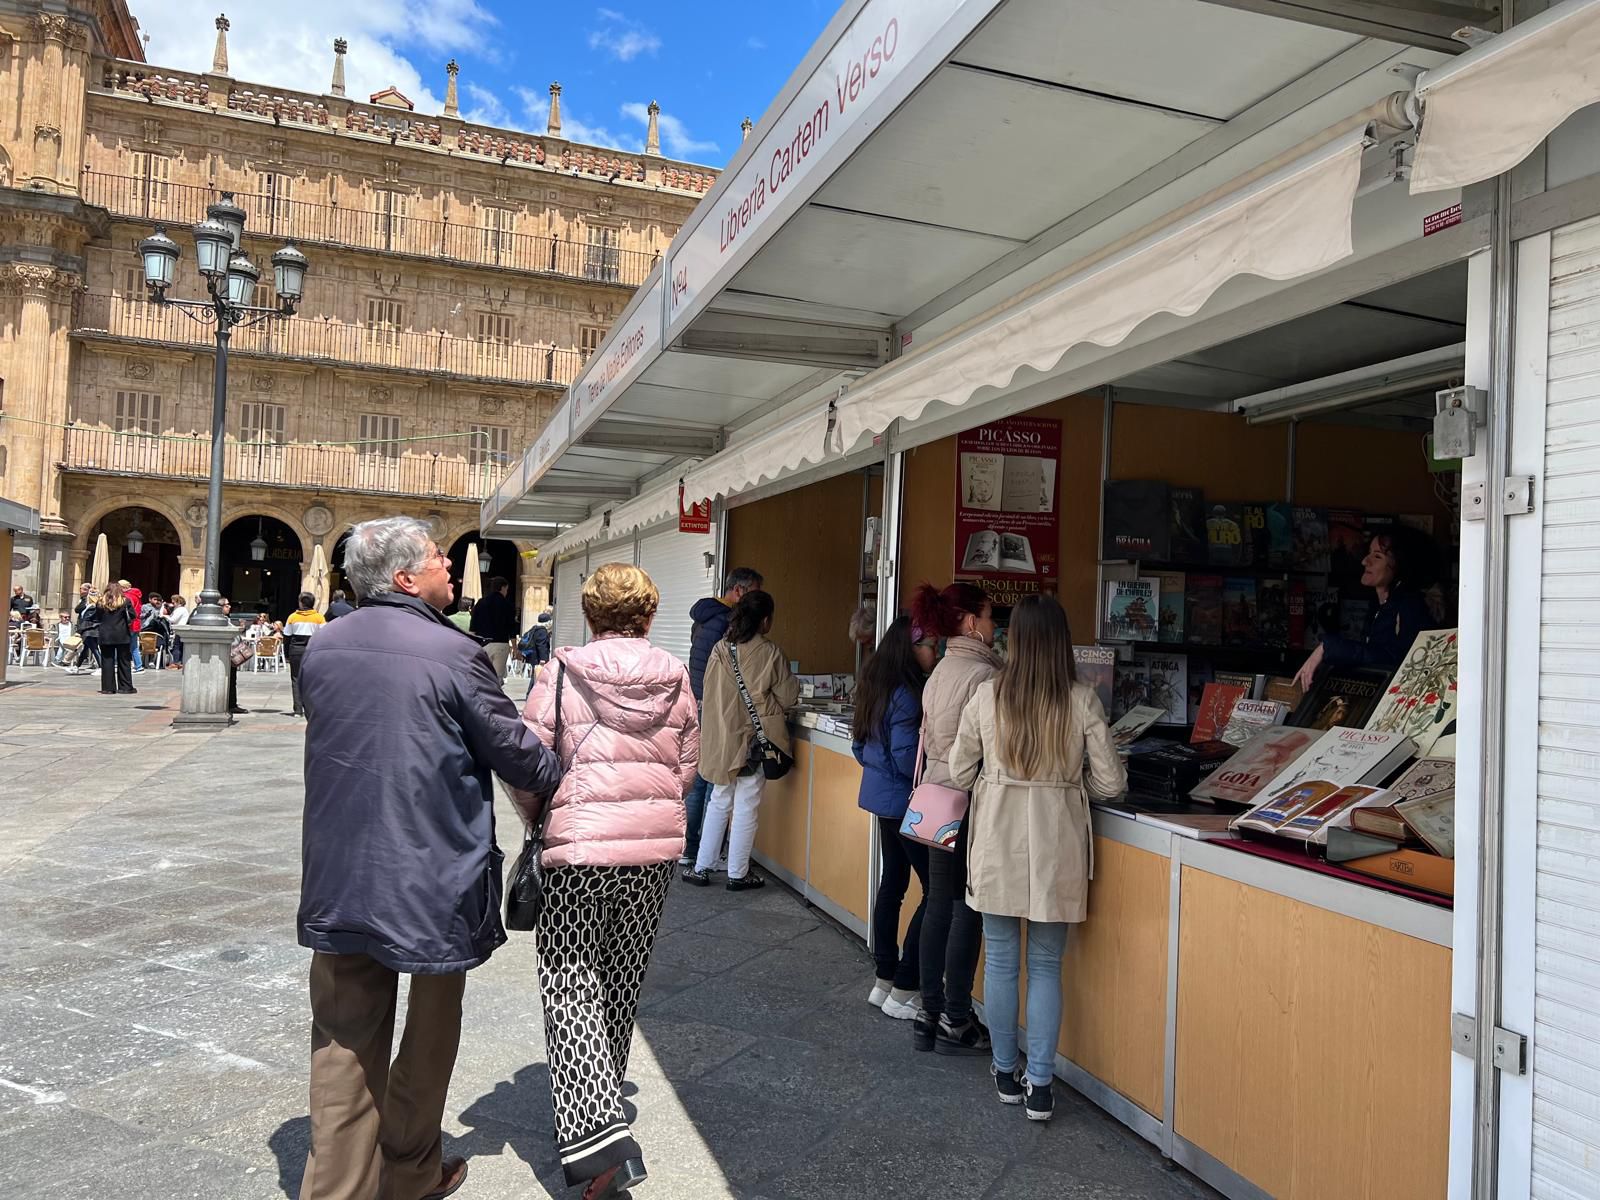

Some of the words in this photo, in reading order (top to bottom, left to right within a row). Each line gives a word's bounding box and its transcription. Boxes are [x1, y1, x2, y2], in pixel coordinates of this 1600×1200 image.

[720, 174, 766, 254] Librería
[769, 99, 829, 194] Cartem
[836, 16, 899, 115] Verso
[620, 325, 644, 368] Editores
[978, 428, 1041, 444] PICASSO
[975, 578, 1039, 592] ABSOLUTE
[1081, 649, 1115, 659] CINCO
[1327, 679, 1377, 697] DURERO
[1338, 730, 1391, 744] PICASSO
[1218, 770, 1261, 788] GOYA
